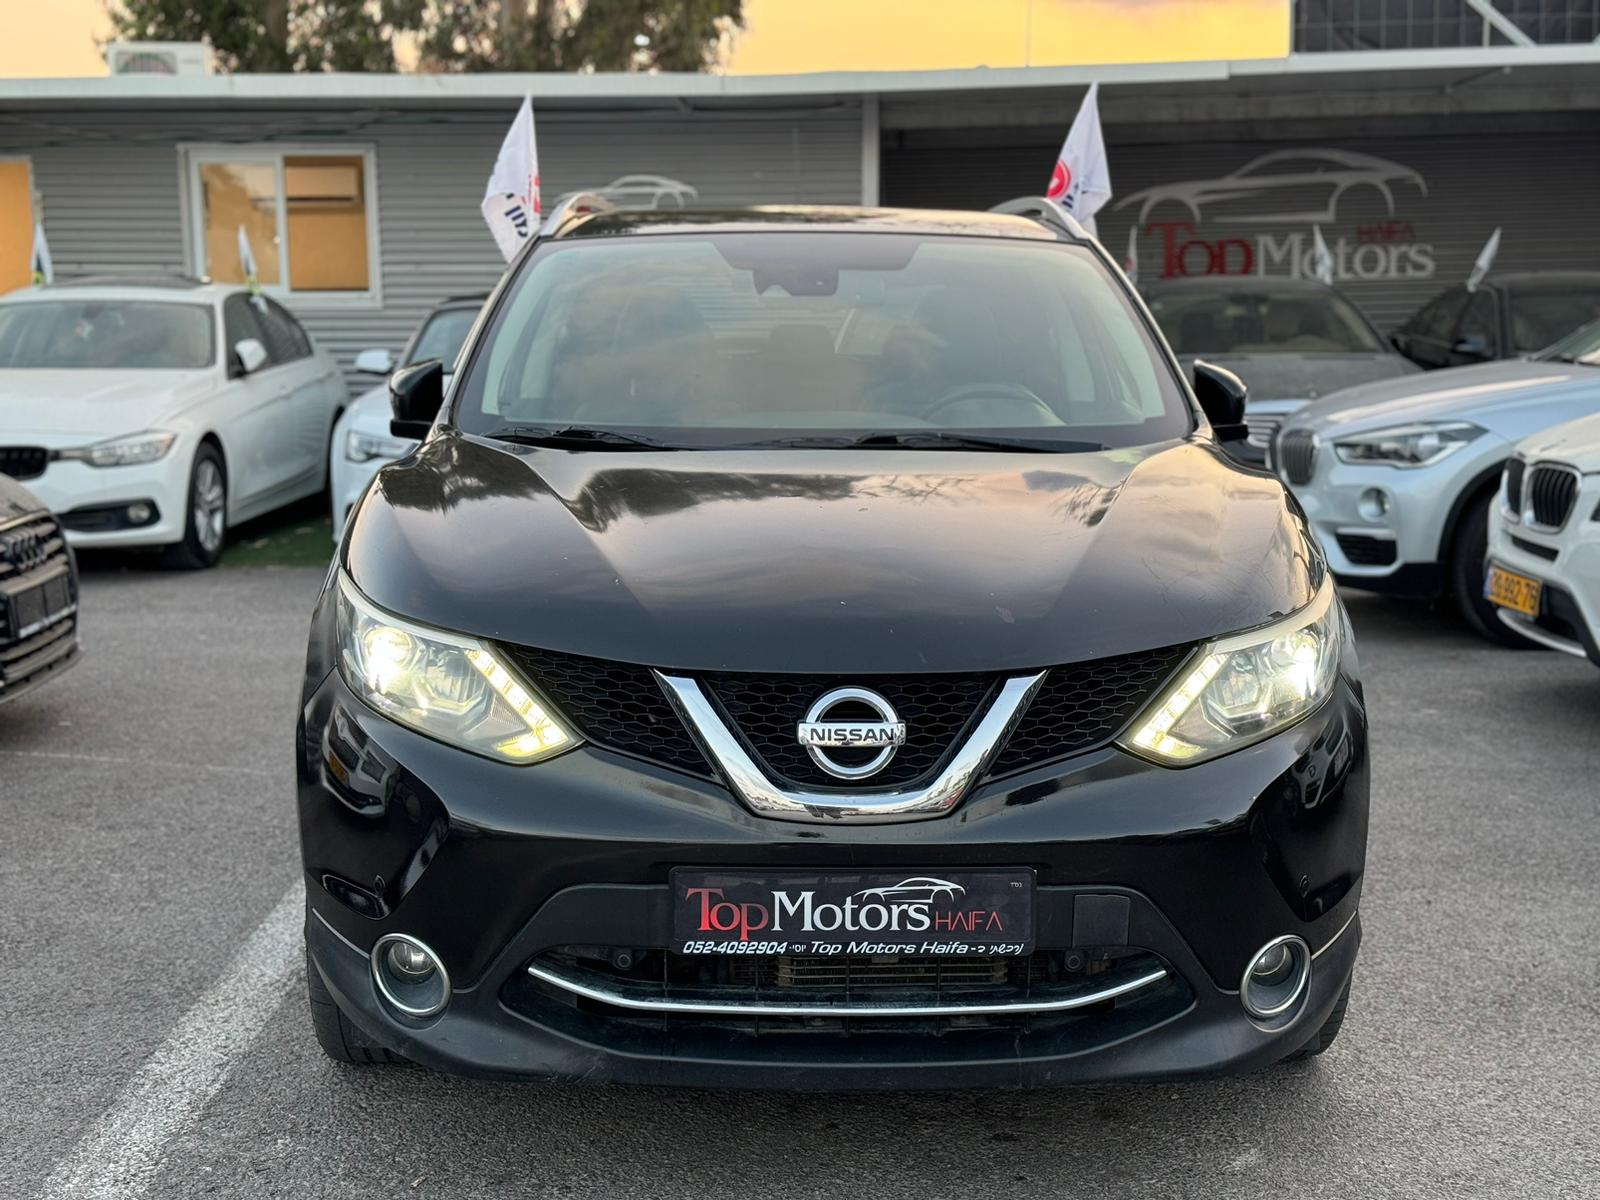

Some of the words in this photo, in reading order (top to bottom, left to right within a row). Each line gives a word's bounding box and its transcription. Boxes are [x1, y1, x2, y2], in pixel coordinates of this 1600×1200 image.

[810, 728, 895, 742] NISSAN
[685, 888, 769, 941] Top
[770, 891, 931, 932] Motors
[935, 911, 1003, 931] HAIFA
[682, 941, 788, 955] 052-4092904
[811, 941, 842, 956] Top
[846, 941, 917, 954] Motors
[919, 941, 969, 954] Haifa
